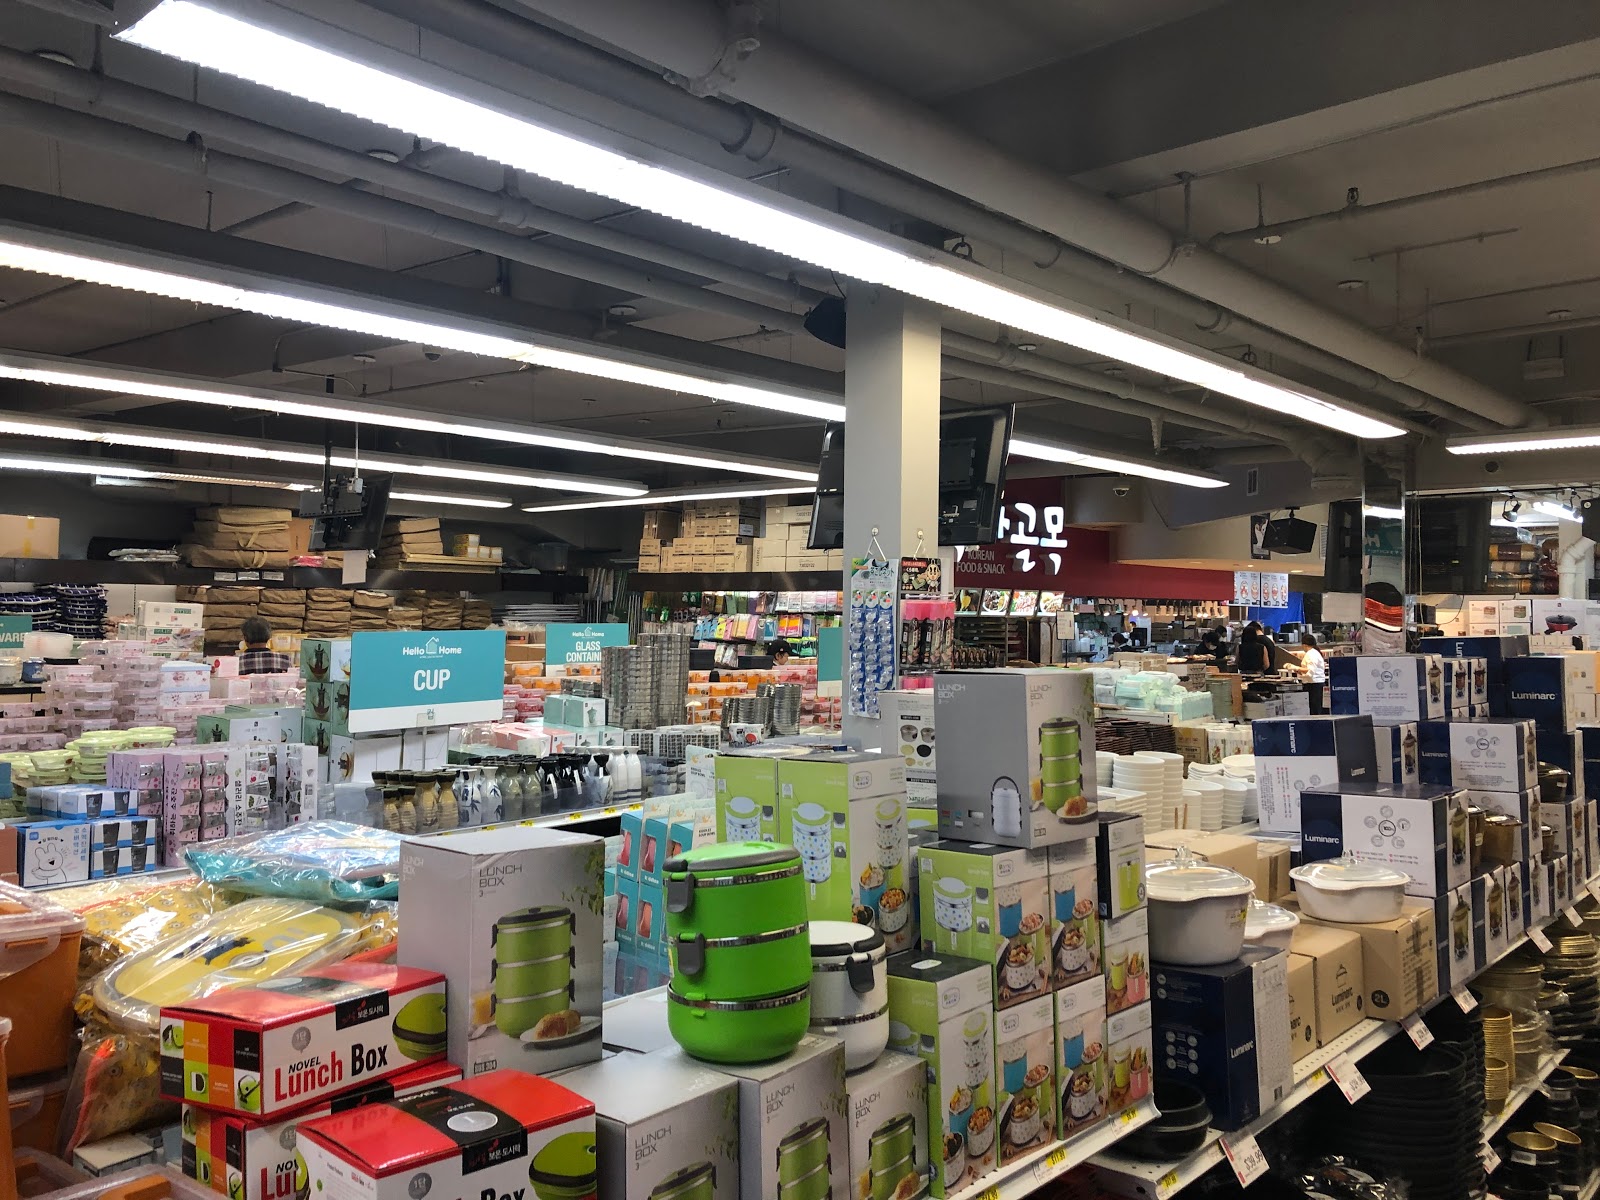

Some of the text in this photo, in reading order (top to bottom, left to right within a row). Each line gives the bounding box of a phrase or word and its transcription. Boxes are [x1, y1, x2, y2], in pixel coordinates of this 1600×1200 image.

[968, 550, 994, 560] KOREAN
[957, 562, 1005, 574] FOOD & SNACK
[403, 646, 462, 656] Hello Home
[576, 641, 600, 651] GLASS
[566, 652, 601, 662] CONTAIN
[414, 669, 450, 691] CUP
[1511, 691, 1556, 700] Luminarc
[1304, 833, 1340, 844] Luminarc
[480, 864, 523, 877] LUNCH
[480, 877, 505, 888] BOX
[1374, 993, 1385, 1004] 2L
[1230, 1041, 1254, 1058] Luminarc
[288, 1056, 321, 1074] NOVEL
[351, 1043, 388, 1077] Box
[275, 1051, 343, 1102] Lunch
[766, 1083, 795, 1104] LUNCH
[766, 1100, 784, 1114] BOX
[855, 1092, 881, 1110] LUNCH
[855, 1106, 871, 1120] BOX
[635, 1125, 672, 1149] LUNCH
[488, 1150, 502, 1162] 보온
[502, 1143, 521, 1157] 도시락
[635, 1143, 658, 1161] BOX
